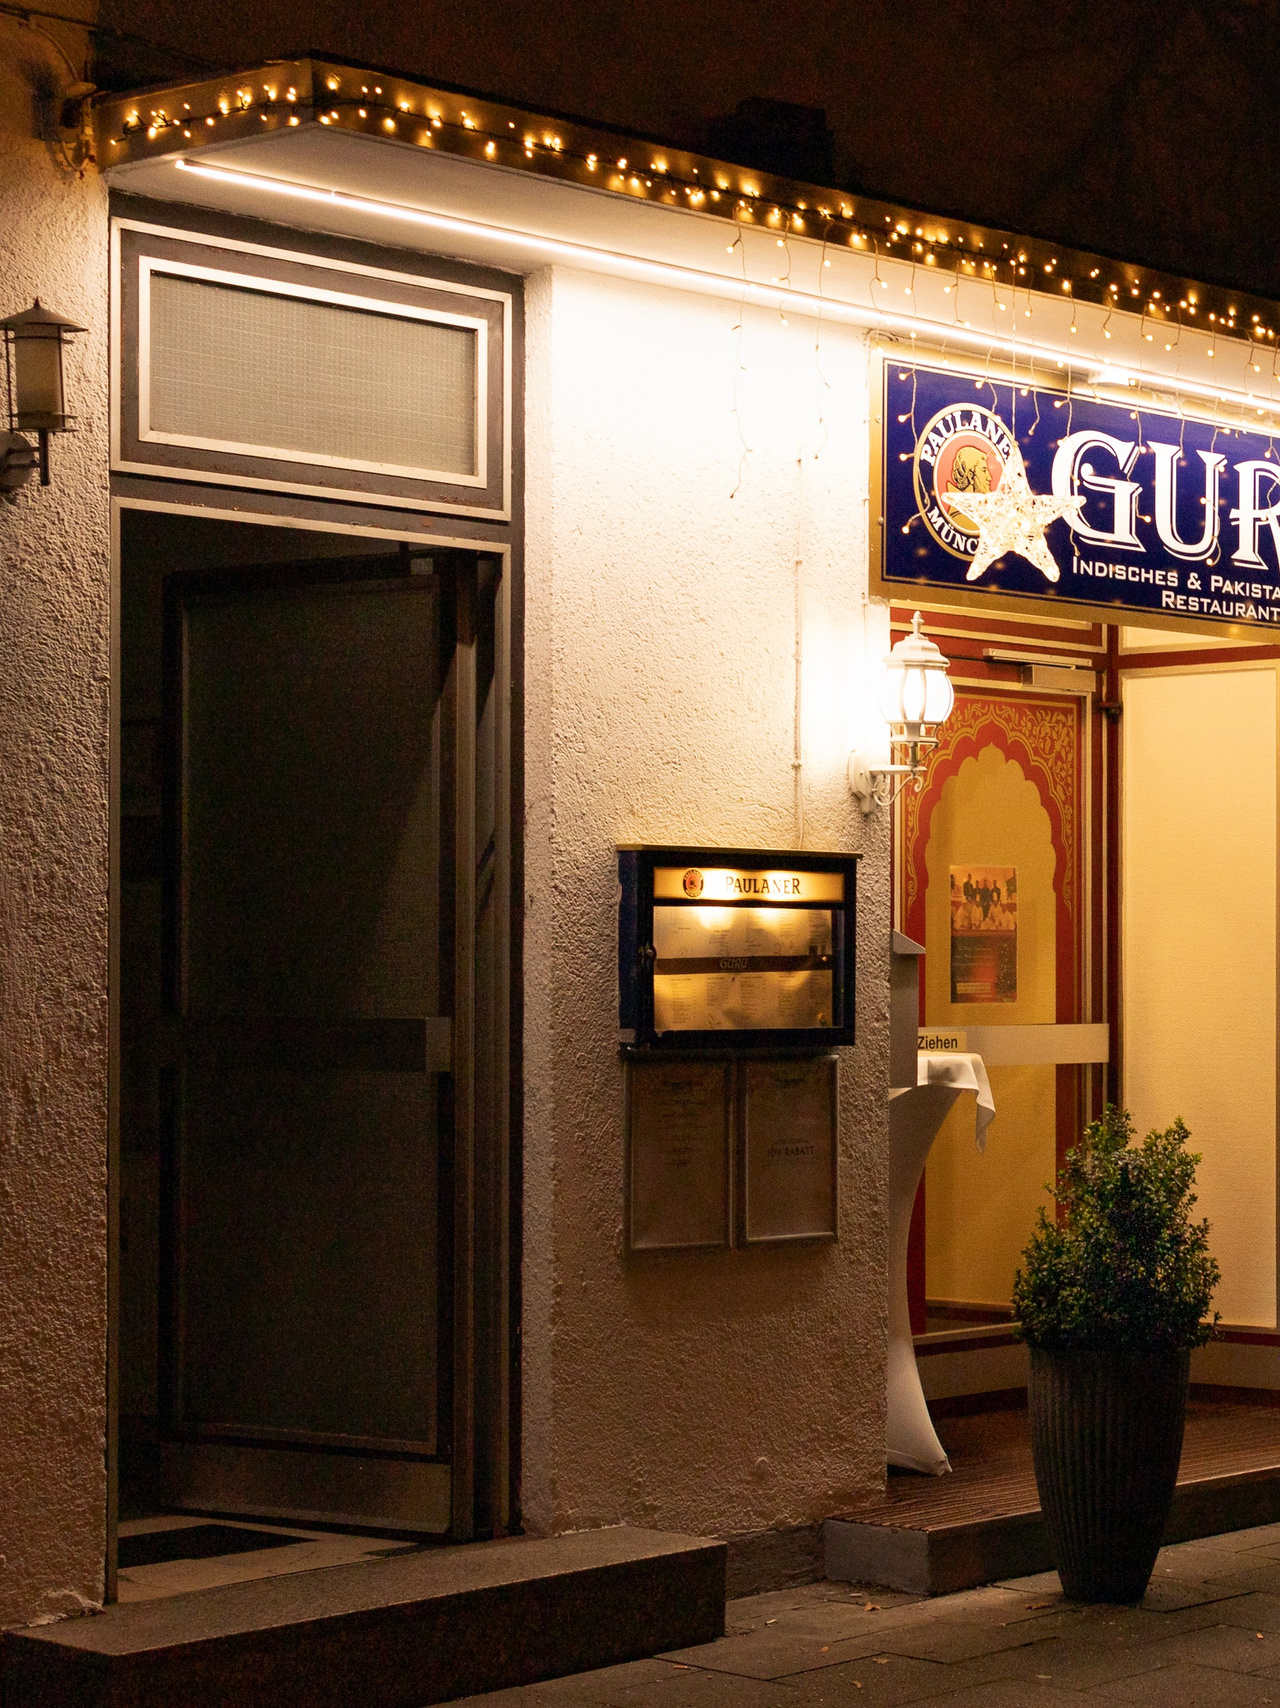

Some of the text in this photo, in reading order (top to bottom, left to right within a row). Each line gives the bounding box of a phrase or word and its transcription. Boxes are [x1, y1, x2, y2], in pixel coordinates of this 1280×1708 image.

[920, 410, 1013, 467] PAULANE
[1072, 555, 1179, 589] INDISCHES
[1187, 572, 1202, 592] &
[1161, 590, 1280, 622] RESTAURANT
[725, 875, 801, 895] PAULANER
[918, 1035, 958, 1050] Ziehen
